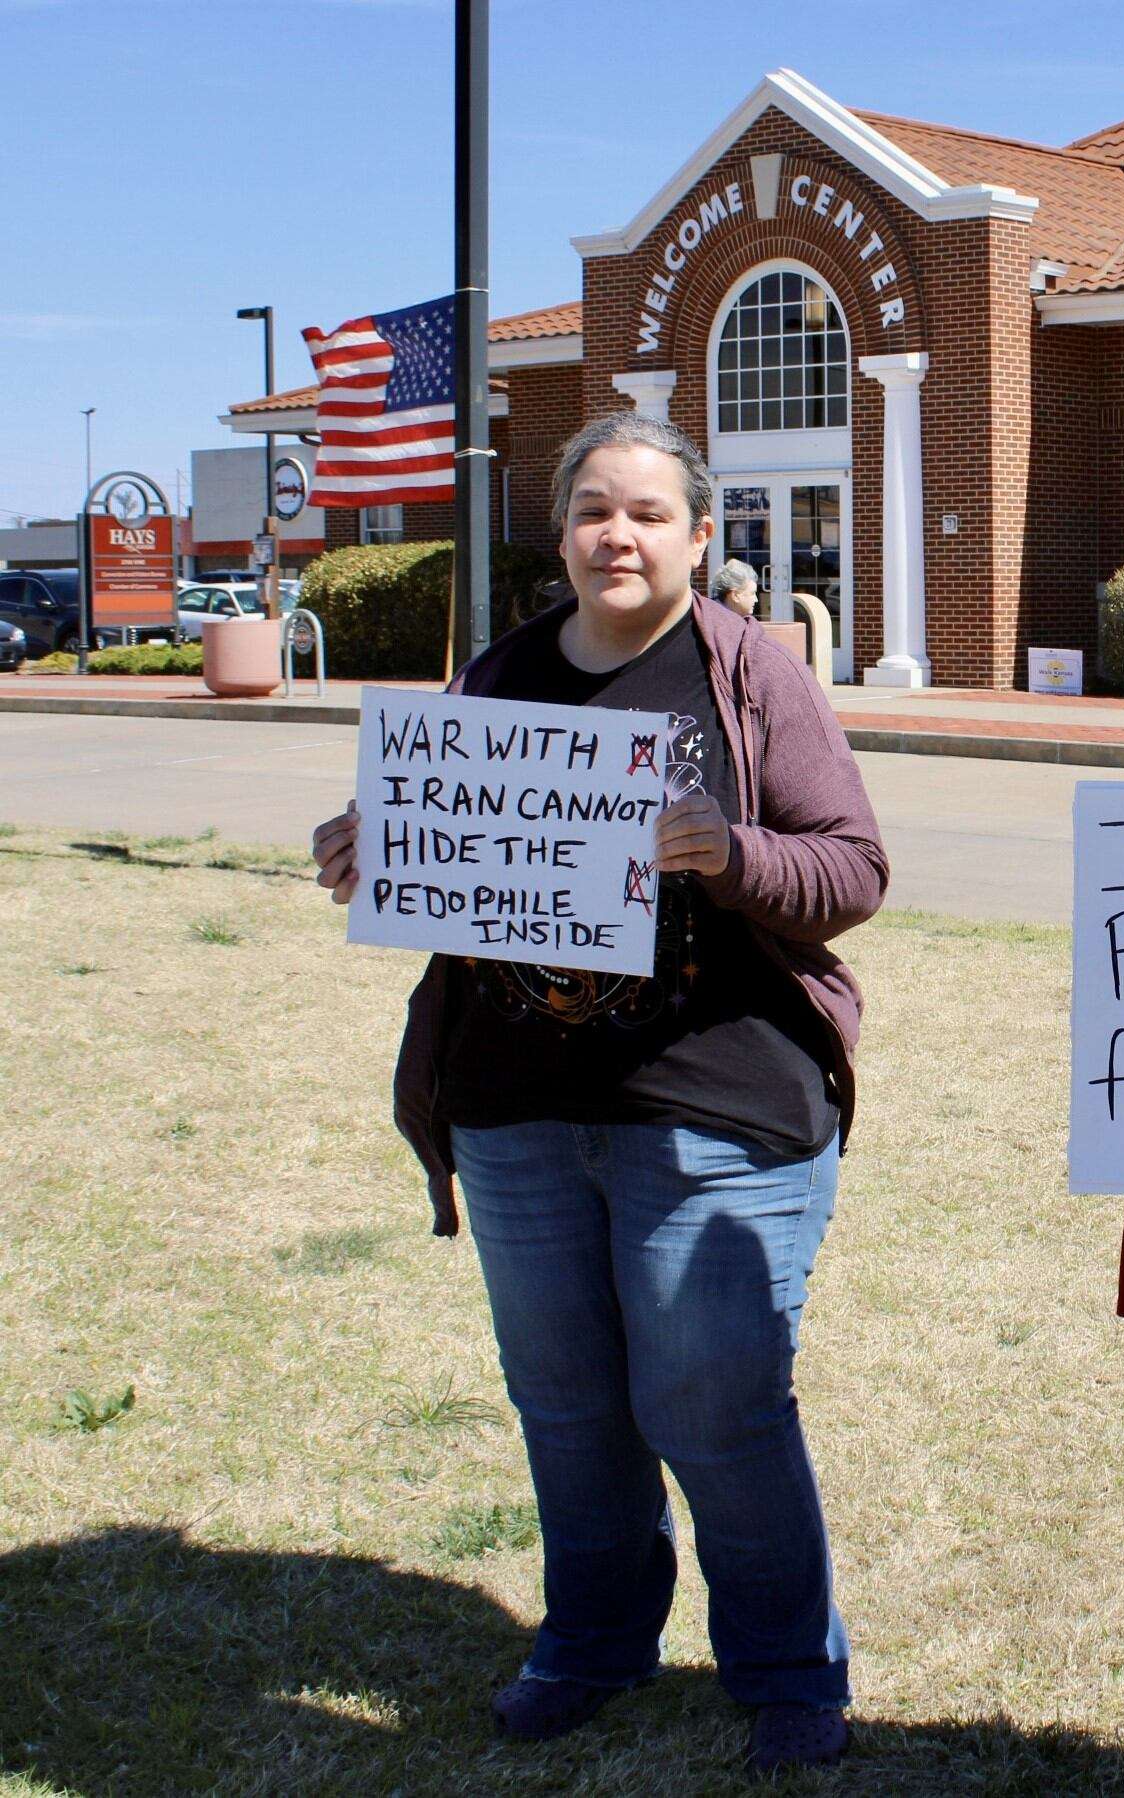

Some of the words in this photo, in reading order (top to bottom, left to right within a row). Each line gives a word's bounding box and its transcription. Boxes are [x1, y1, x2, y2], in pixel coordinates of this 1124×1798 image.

[636, 182, 743, 354] WELCOME
[791, 175, 905, 329] CENTER
[108, 528, 156, 545] HAYS
[379, 708, 470, 764] WAR
[486, 724, 600, 770] WITH
[382, 776, 506, 816] IRAN
[517, 787, 660, 826] CANNOT
[384, 819, 486, 868] HIDE
[493, 836, 588, 869] THE
[373, 878, 577, 919] PEDOPHILE
[471, 919, 624, 951] INSIDE
